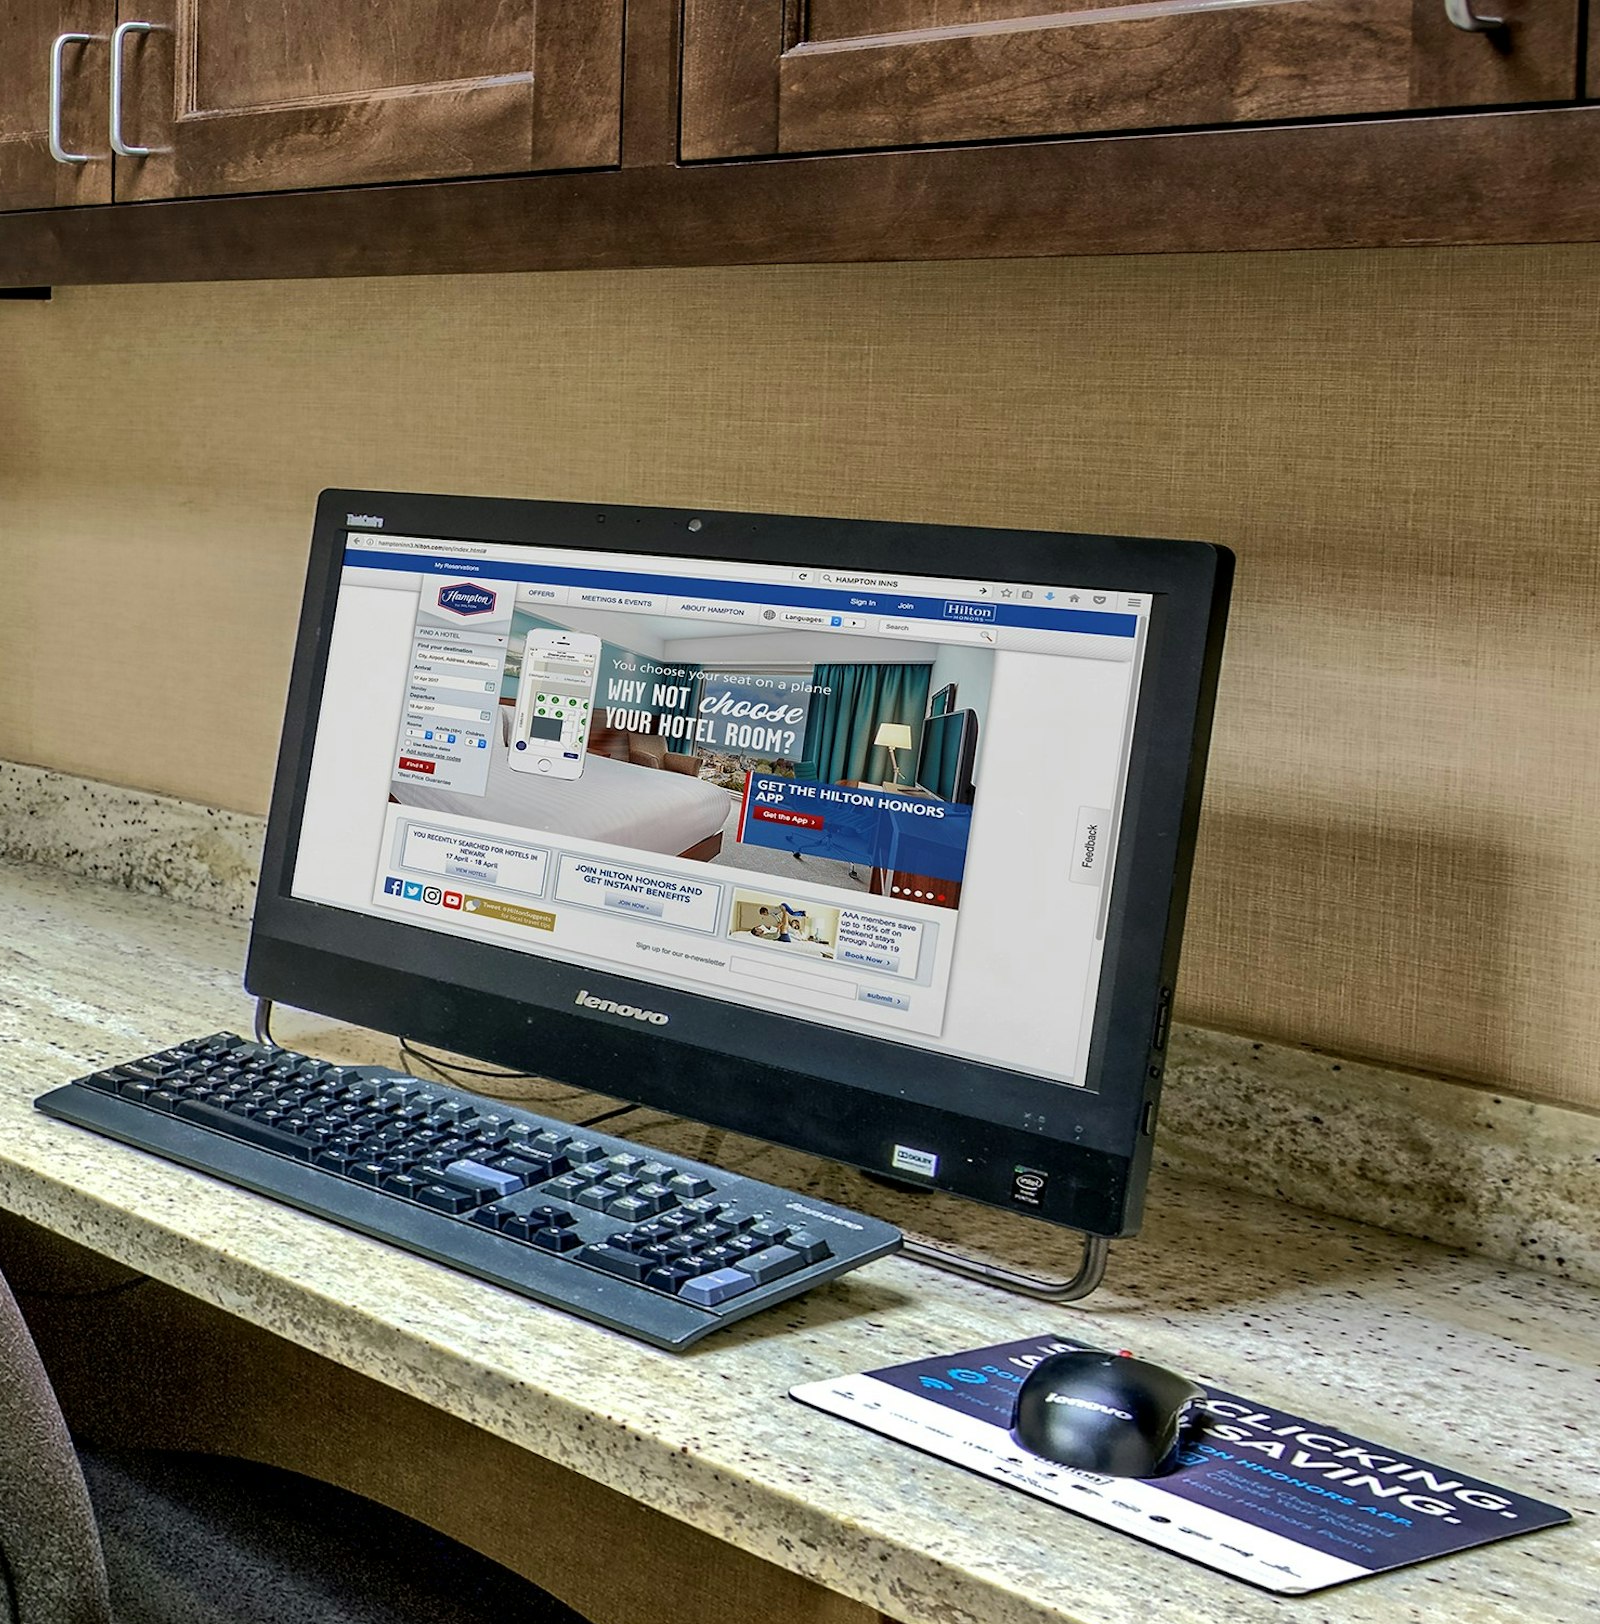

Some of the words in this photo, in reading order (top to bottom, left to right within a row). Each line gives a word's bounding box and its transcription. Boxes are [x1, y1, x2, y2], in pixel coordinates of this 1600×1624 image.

[836, 577, 876, 586] HAMPTON
[442, 590, 493, 604] Hampton
[528, 590, 555, 598] OFFERS
[581, 595, 617, 604] MEETINGS
[624, 599, 652, 607] EVENTS
[850, 598, 867, 606] Sign
[681, 604, 706, 612] ABOUT
[707, 606, 745, 616] HAMPTON
[898, 602, 914, 610] Join
[949, 604, 992, 617] Hilton
[785, 614, 825, 623] Languages:
[612, 659, 636, 671] You
[640, 663, 685, 678] choose
[689, 670, 719, 680] your
[723, 674, 751, 685] seat
[756, 679, 773, 688] on
[778, 682, 785, 690] a
[791, 681, 832, 695] plane
[608, 678, 647, 704] WHY
[652, 683, 691, 710] NOT
[699, 691, 804, 725] choose
[605, 706, 651, 734] YOUR
[658, 714, 717, 744] HOTEL
[725, 722, 796, 755] ROOM?
[755, 792, 784, 804] APP
[757, 780, 786, 792] GET
[788, 784, 816, 798] THE
[819, 789, 874, 806] HILTON
[878, 797, 946, 819] HONORS
[763, 810, 777, 819] Get
[779, 812, 791, 821] the
[792, 814, 808, 825] App
[1082, 824, 1098, 869] Feedback
[575, 864, 597, 875] JOIN
[599, 869, 634, 882] HILTON
[636, 877, 677, 891] HONORS
[679, 885, 703, 896] AND
[583, 875, 602, 885] GET
[604, 880, 644, 893] INSTANT
[646, 888, 691, 903] BENEFITS
[575, 990, 669, 1025] lenovo
[1045, 1393, 1134, 1420] lenovo
[1203, 1399, 1518, 1519] CLICKING.
[1202, 1424, 1462, 1524] SAVING.
